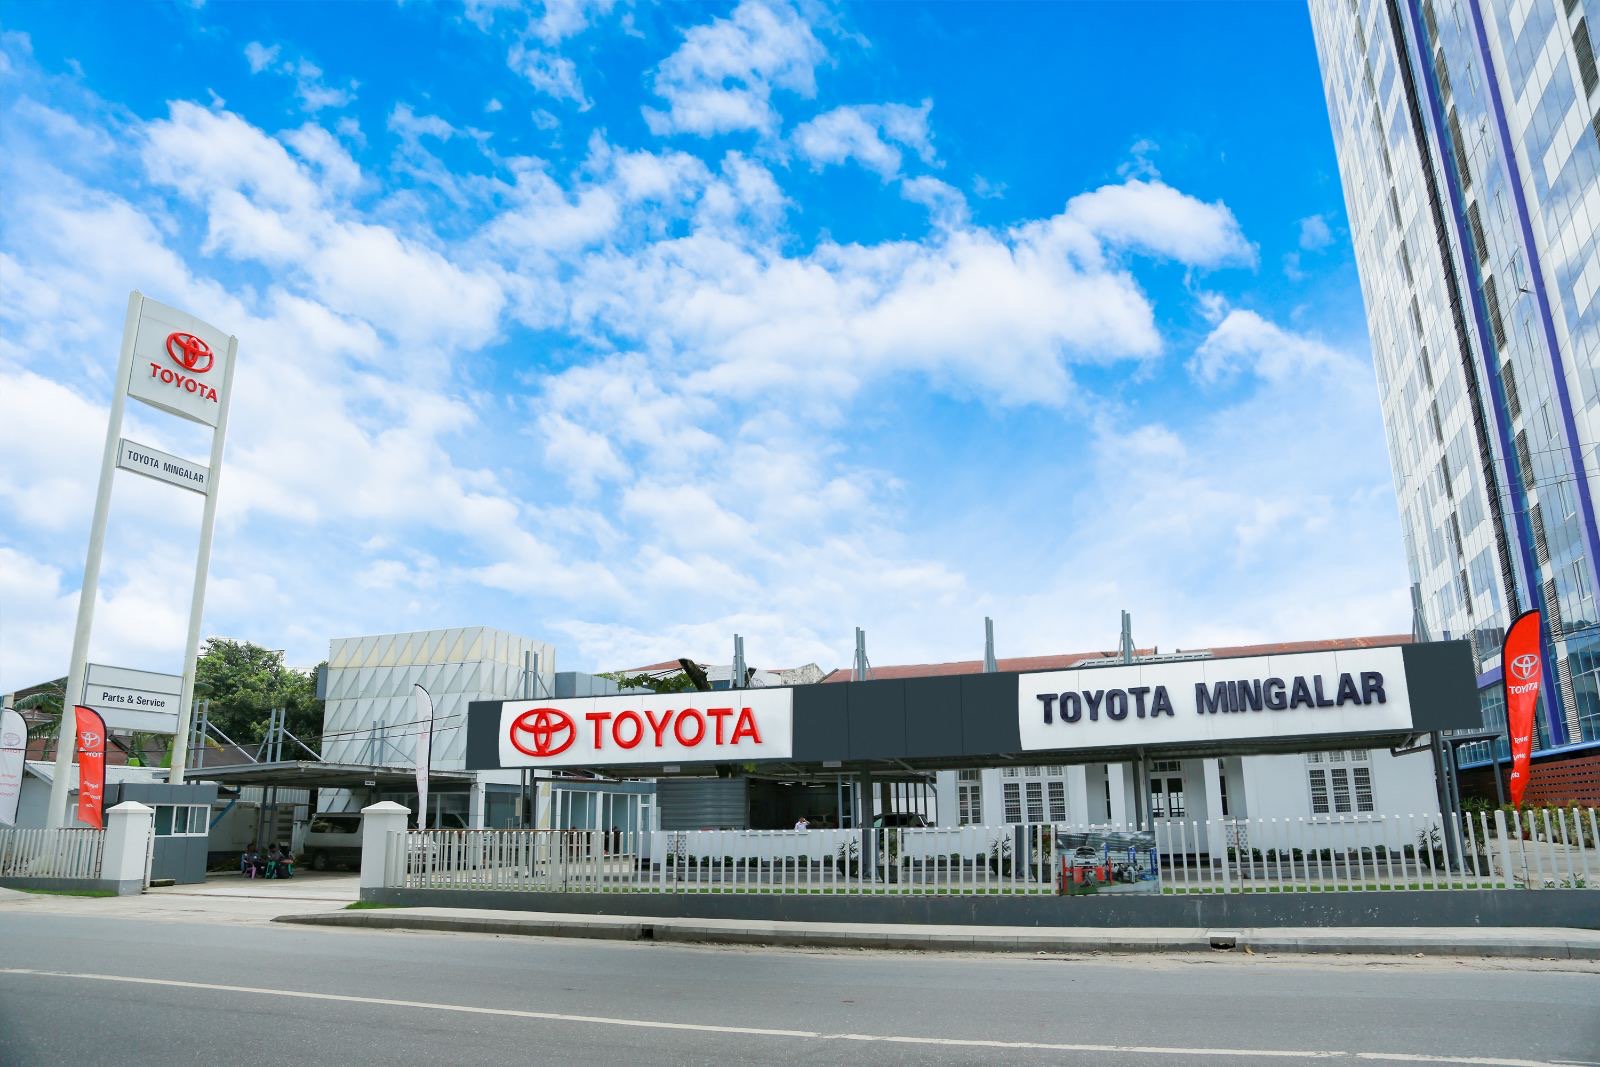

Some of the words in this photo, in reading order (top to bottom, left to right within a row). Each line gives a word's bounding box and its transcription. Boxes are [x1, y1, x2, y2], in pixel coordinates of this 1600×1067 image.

[150, 363, 218, 403] TOYOTA
[127, 450, 159, 469] TOYOTA
[163, 462, 204, 483] MINGALAR
[102, 691, 125, 703] Parts
[127, 694, 134, 704] &
[136, 696, 165, 708] Service
[1036, 684, 1175, 725] TOYOTA
[1194, 671, 1387, 714] MINGALAR
[585, 707, 763, 750] TOYOTA
